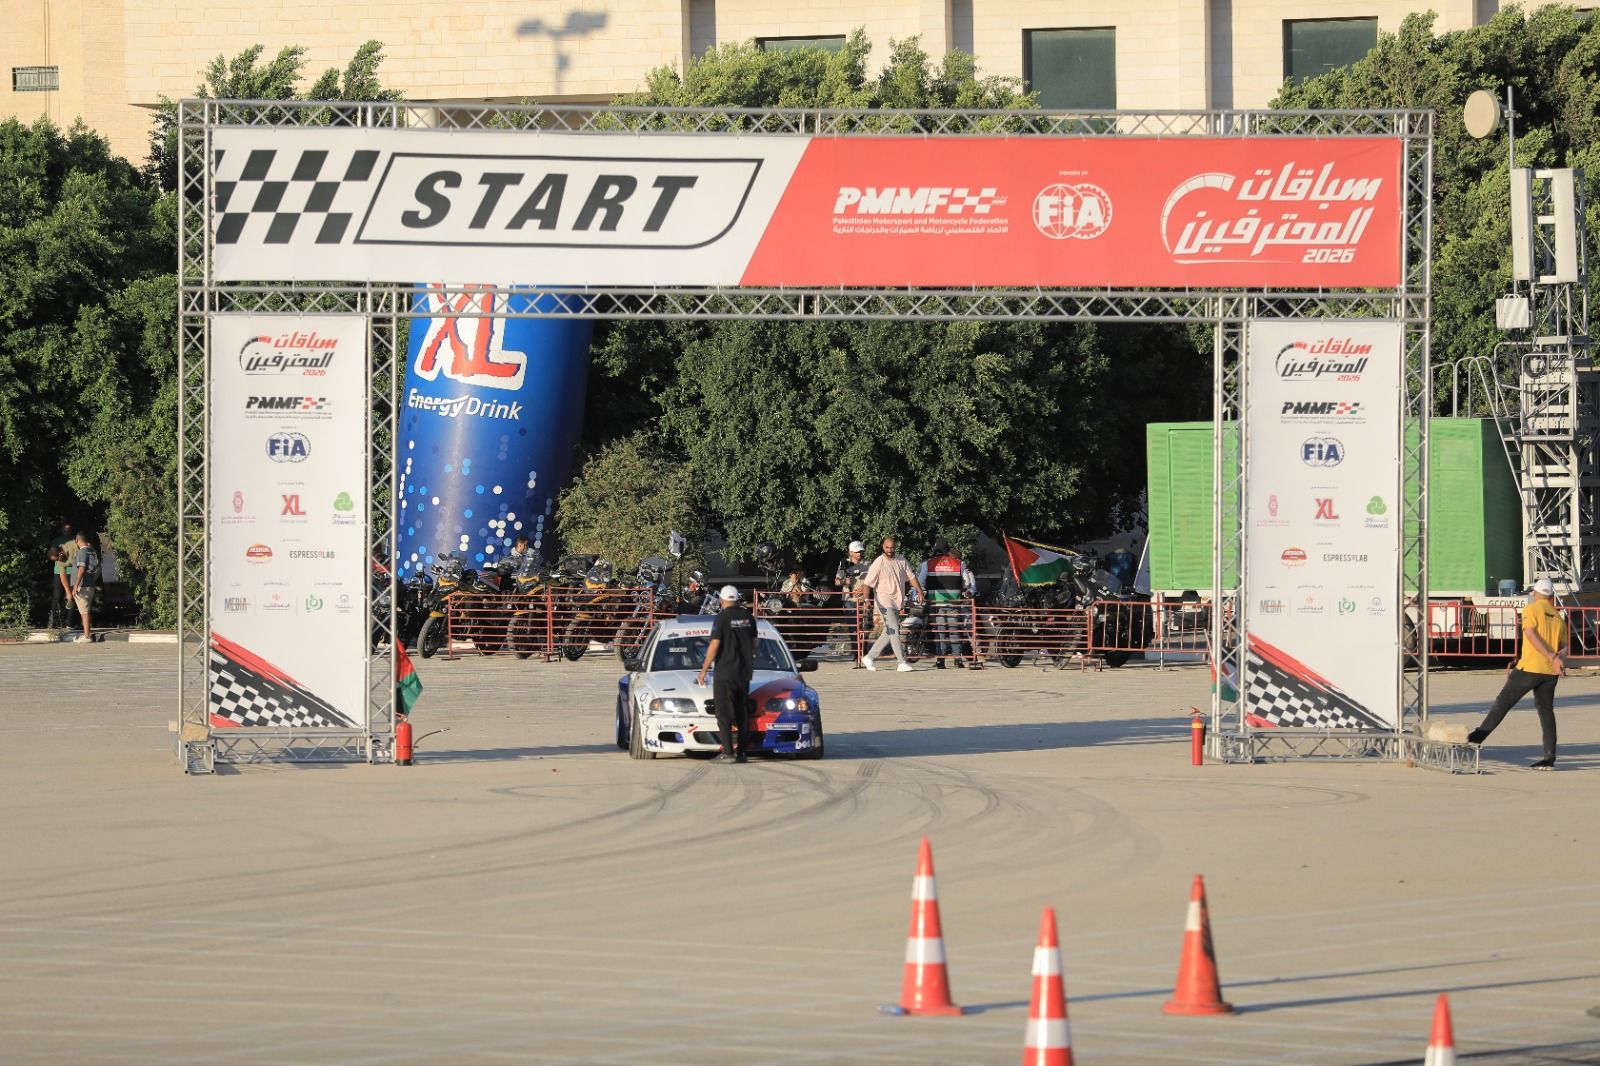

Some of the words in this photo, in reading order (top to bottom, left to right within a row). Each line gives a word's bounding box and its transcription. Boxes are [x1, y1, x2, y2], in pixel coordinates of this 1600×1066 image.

[1236, 161, 1383, 210] سباقات
[400, 170, 699, 233] START
[833, 187, 952, 215] PMMF
[832, 217, 872, 225] Palestinian
[873, 217, 913, 226] Motorsport
[914, 217, 928, 225] and
[928, 217, 968, 226] Motorcycle
[969, 217, 1009, 225] Federation
[1173, 206, 1375, 257] المحترفين
[1302, 248, 1357, 264] 2026
[273, 331, 338, 352] سباقات
[417, 284, 525, 384] XL
[1309, 337, 1373, 358] سباقات
[245, 351, 335, 373] المحترفين
[1281, 357, 1369, 378] المحترفين
[302, 369, 326, 377] 2026
[1337, 374, 1361, 382] 2026
[246, 396, 305, 410] PMMF
[408, 388, 468, 418] Energy
[466, 397, 522, 420] Drink
[1282, 401, 1338, 415] PMMF
[281, 494, 307, 516] XL
[1314, 498, 1340, 520] XL
